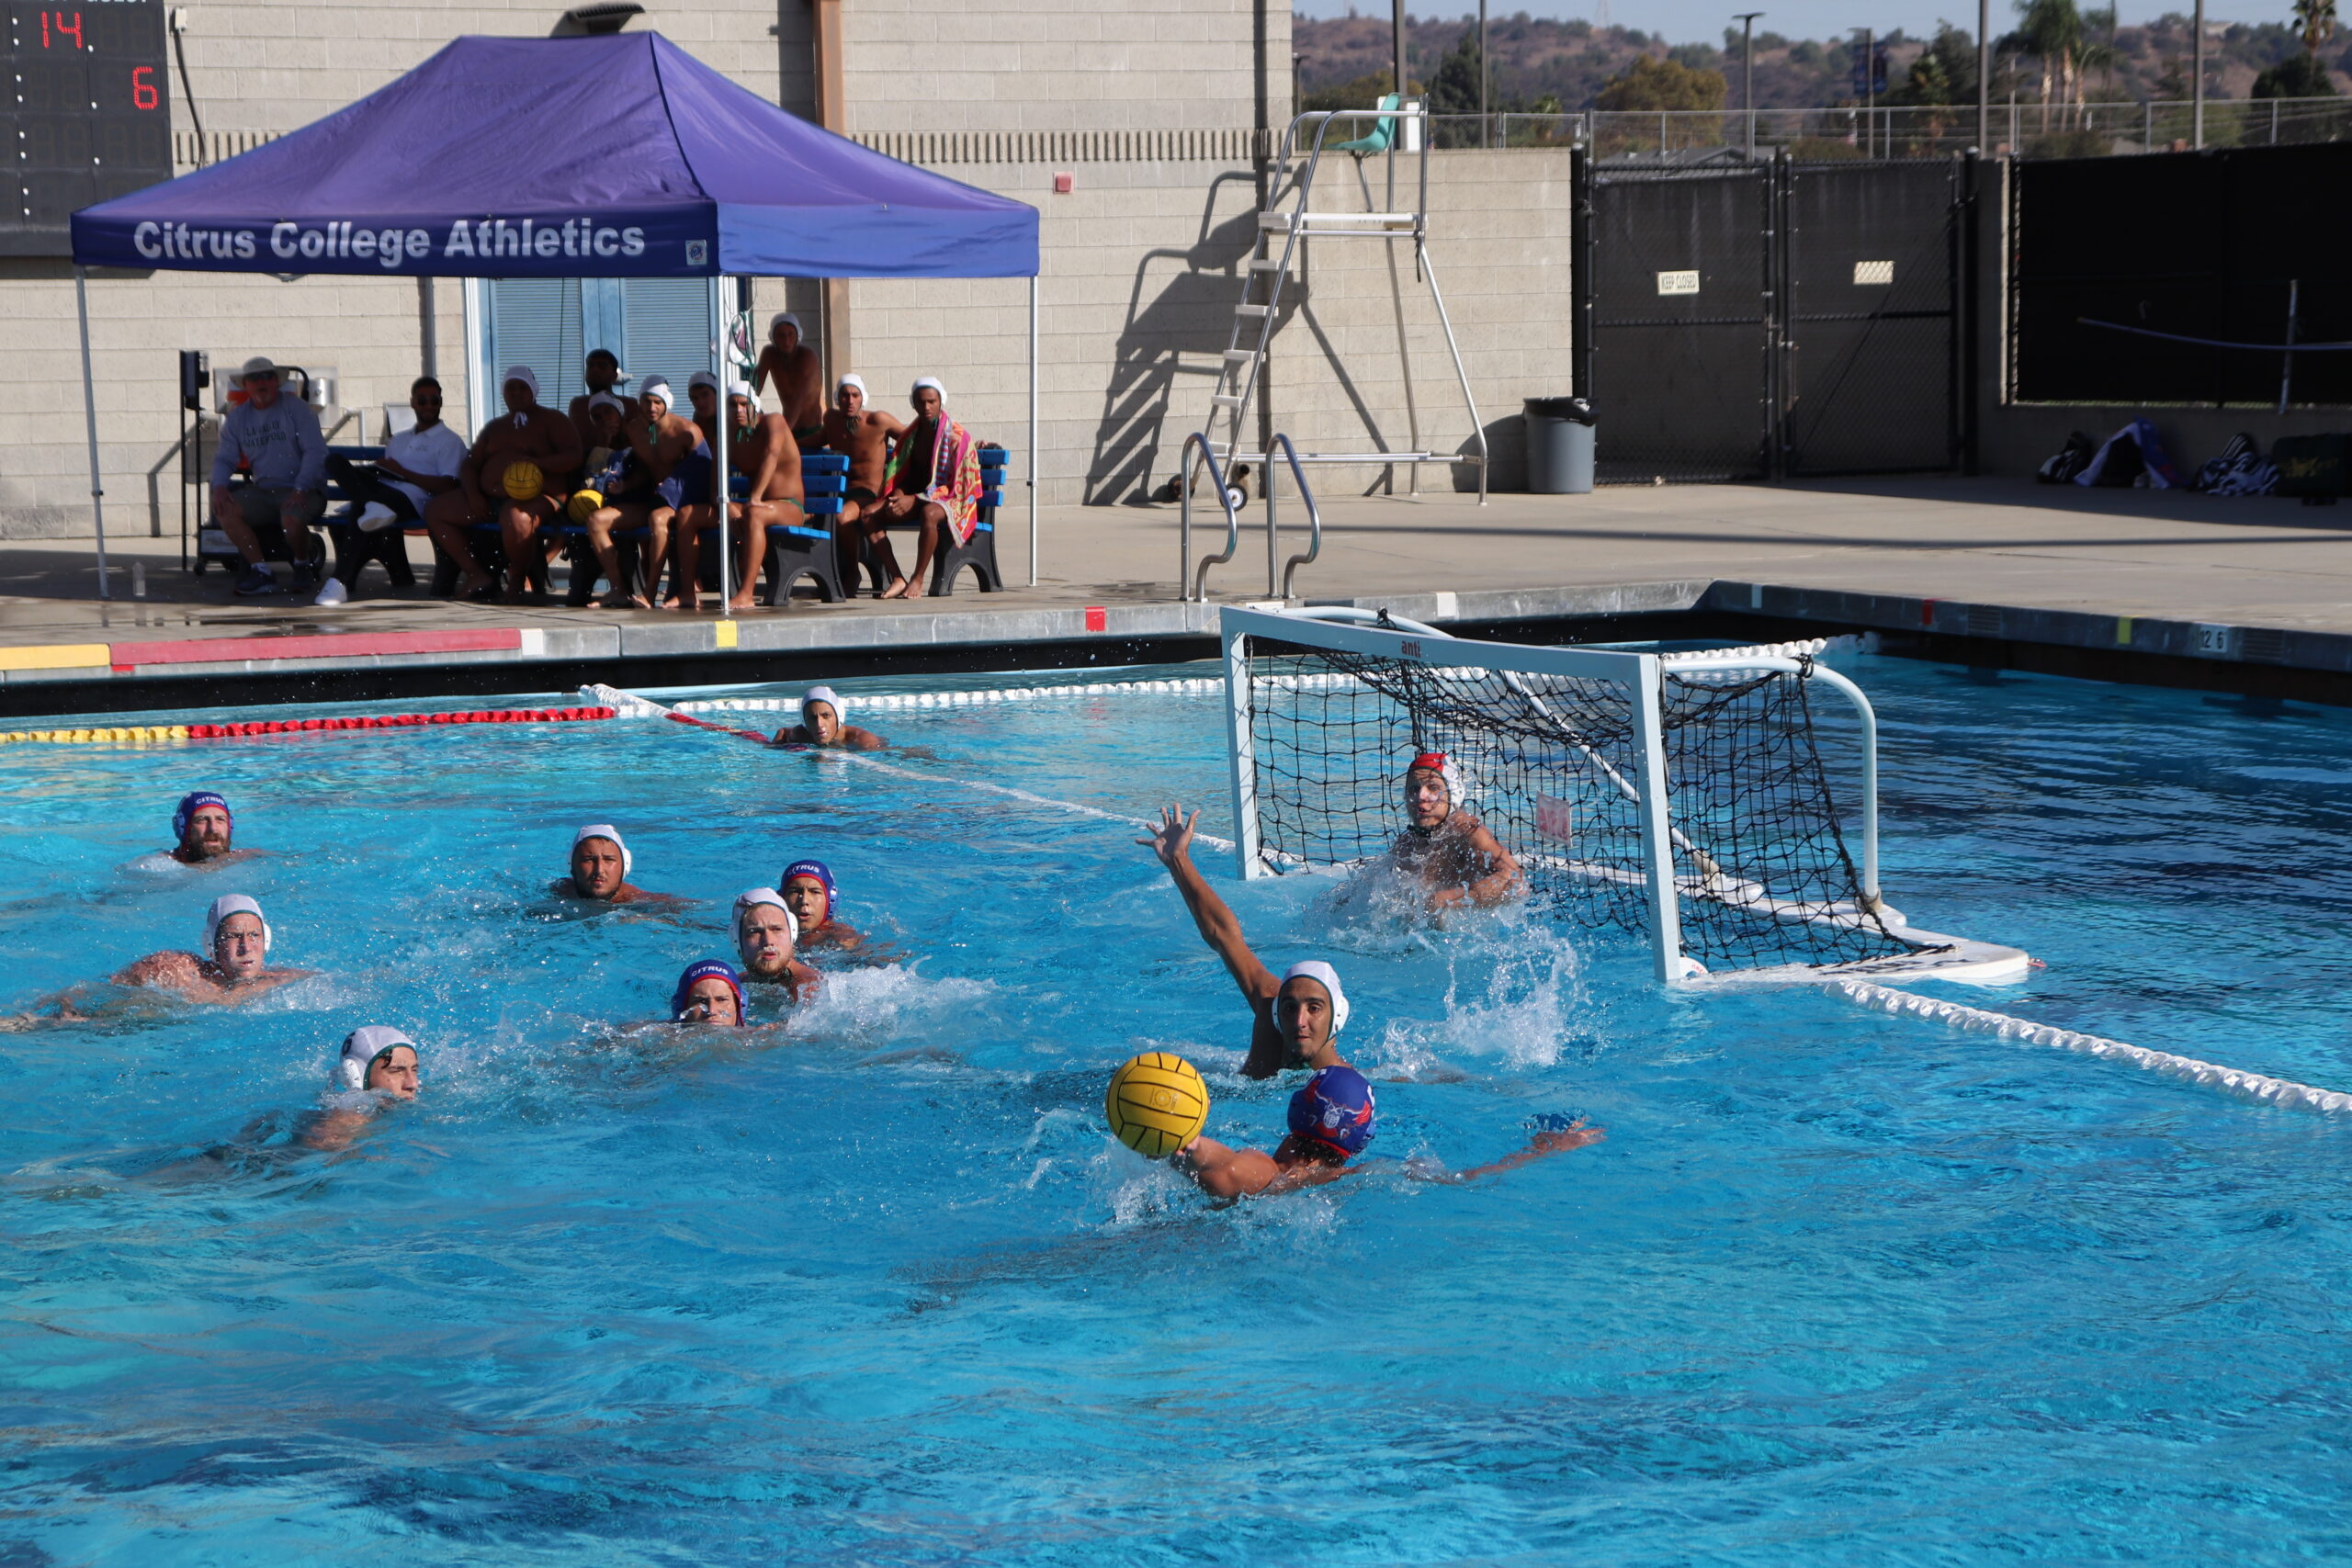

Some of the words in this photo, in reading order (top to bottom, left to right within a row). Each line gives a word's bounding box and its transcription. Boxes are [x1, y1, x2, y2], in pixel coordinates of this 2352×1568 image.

[41, 11, 83, 49] 14
[132, 66, 159, 110] 6
[133, 220, 256, 259] Citrus
[270, 219, 430, 267] College
[444, 218, 646, 258] Athletics
[1401, 640, 1421, 659] anti
[196, 795, 225, 805] CITRUS
[691, 965, 729, 976] CITRUS
